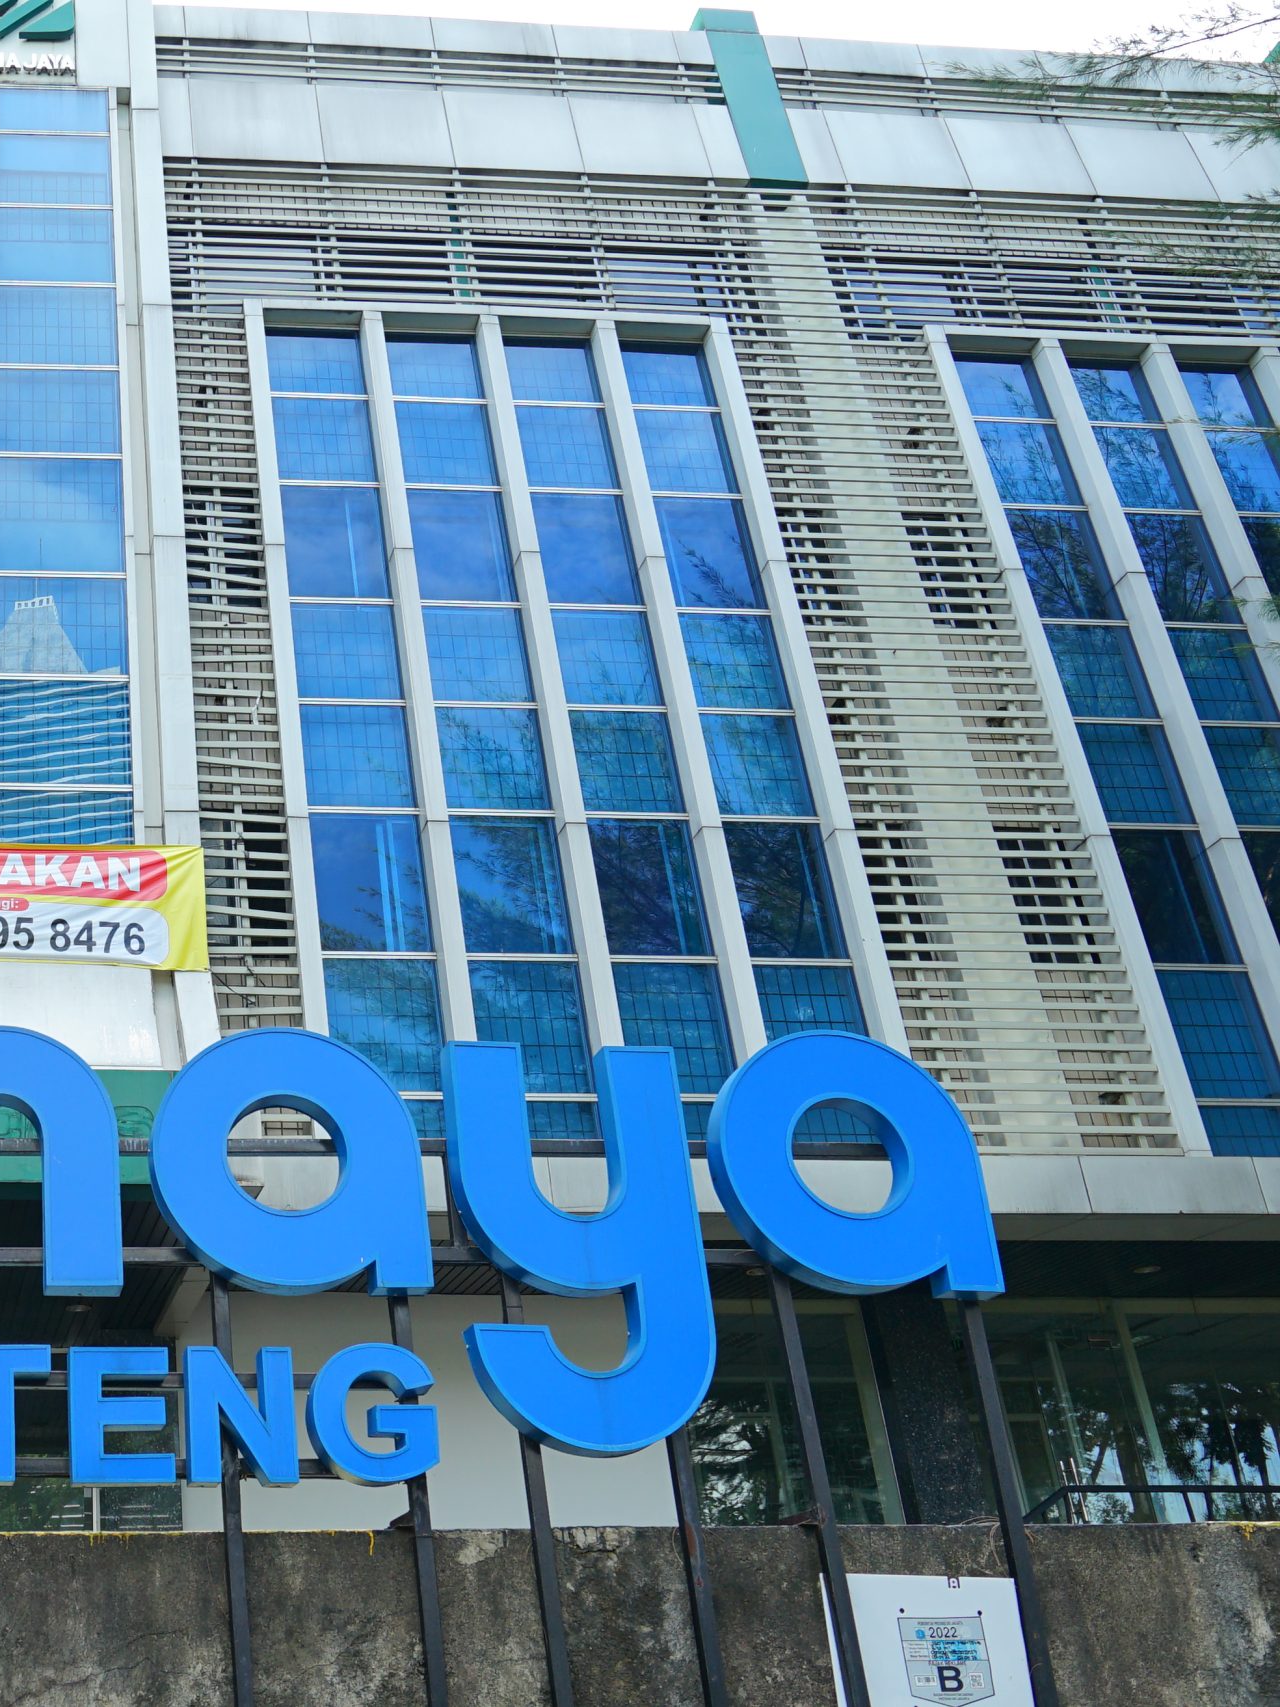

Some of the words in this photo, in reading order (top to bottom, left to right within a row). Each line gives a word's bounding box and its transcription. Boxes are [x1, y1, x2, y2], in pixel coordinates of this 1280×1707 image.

[50, 918, 146, 955] 8476
[928, 1626, 958, 1639] 2022
[937, 1665, 964, 1693] B
